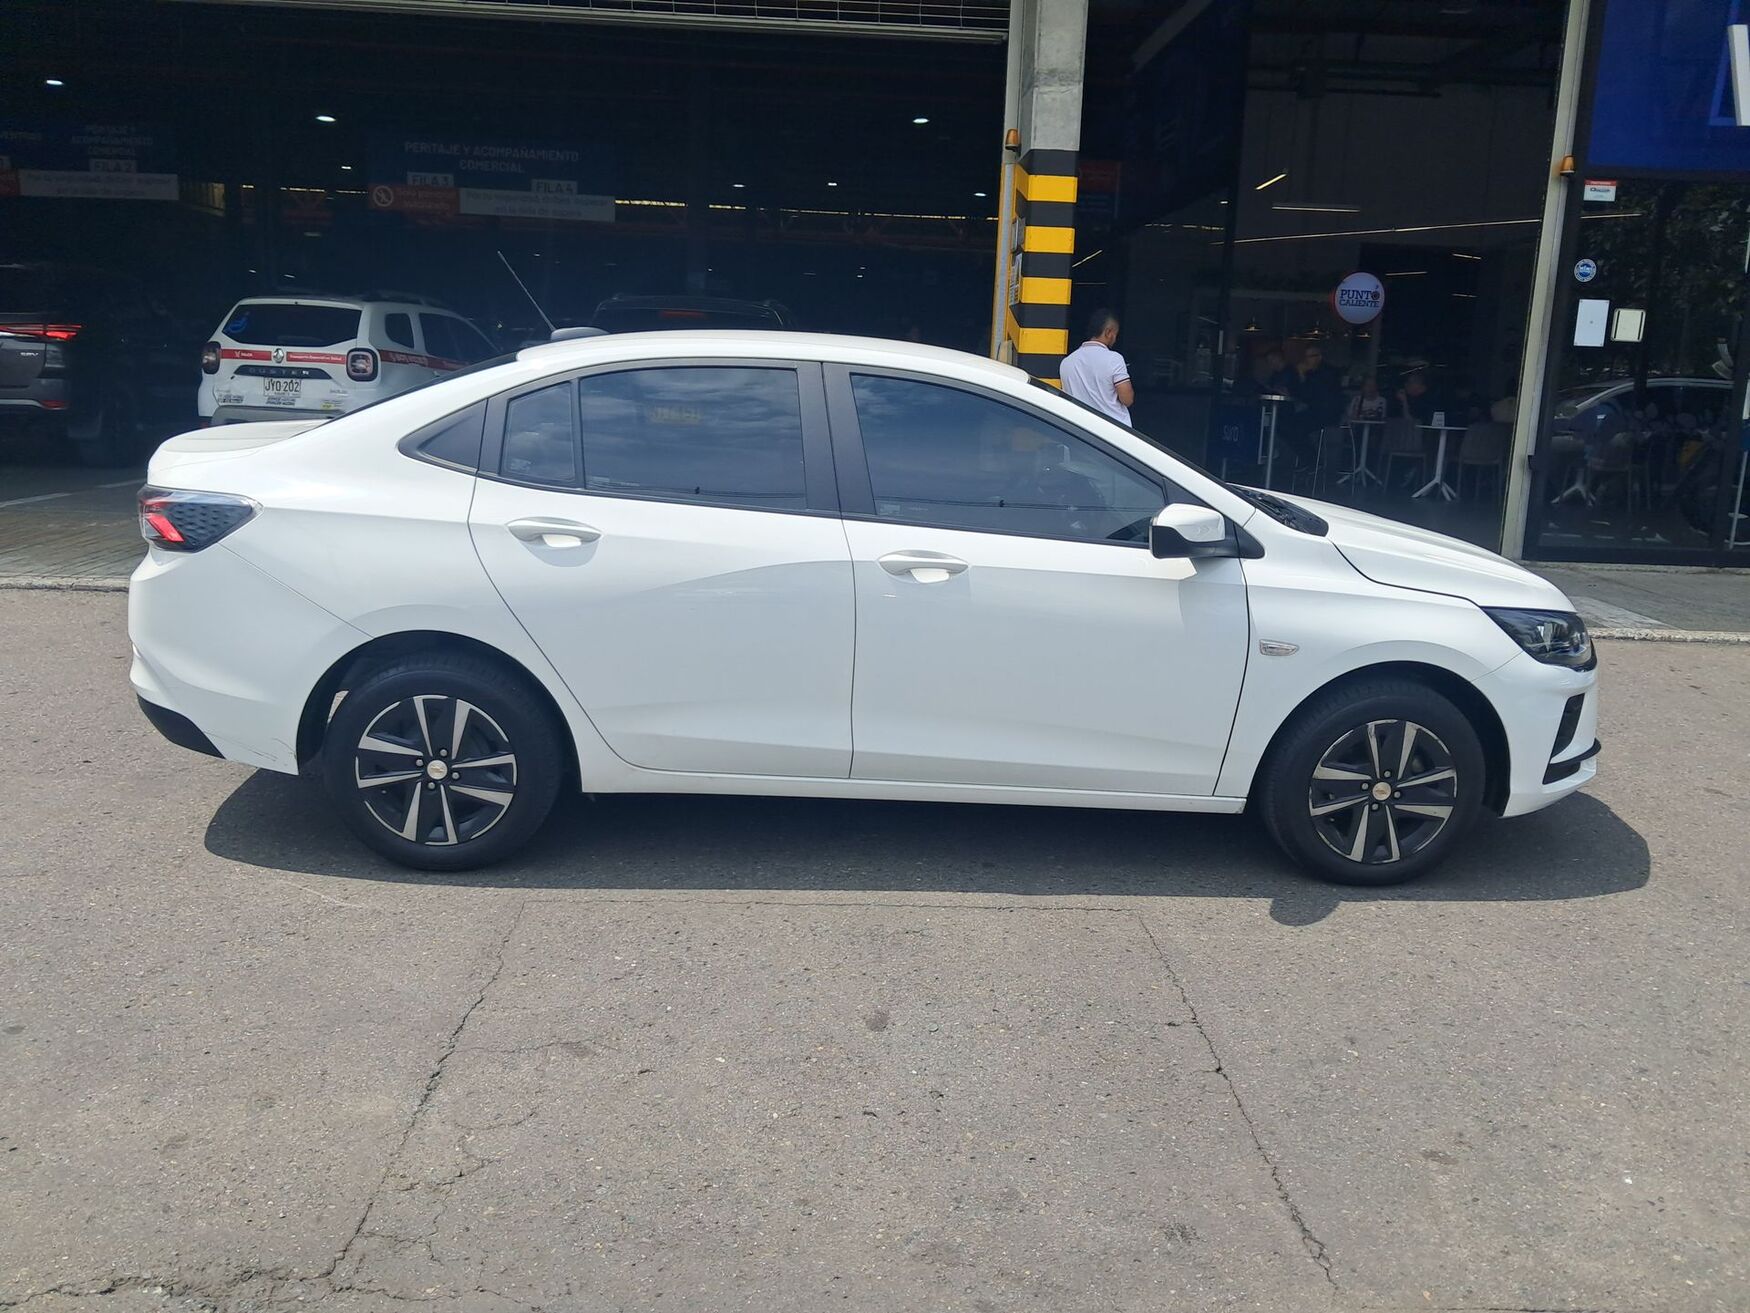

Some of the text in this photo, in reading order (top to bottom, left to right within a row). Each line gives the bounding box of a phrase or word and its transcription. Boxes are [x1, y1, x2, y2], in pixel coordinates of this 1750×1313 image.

[405, 141, 580, 162] PERITAJE Y ACOMPAÑAMIENTO
[94, 161, 122, 172] FILA
[459, 159, 526, 174] COMERCIAL
[411, 175, 450, 187] FILA 3
[535, 181, 565, 193] FILA
[1340, 289, 1380, 301] PUNTO
[1339, 299, 1380, 308] CALIENTE
[283, 380, 300, 392] 202
